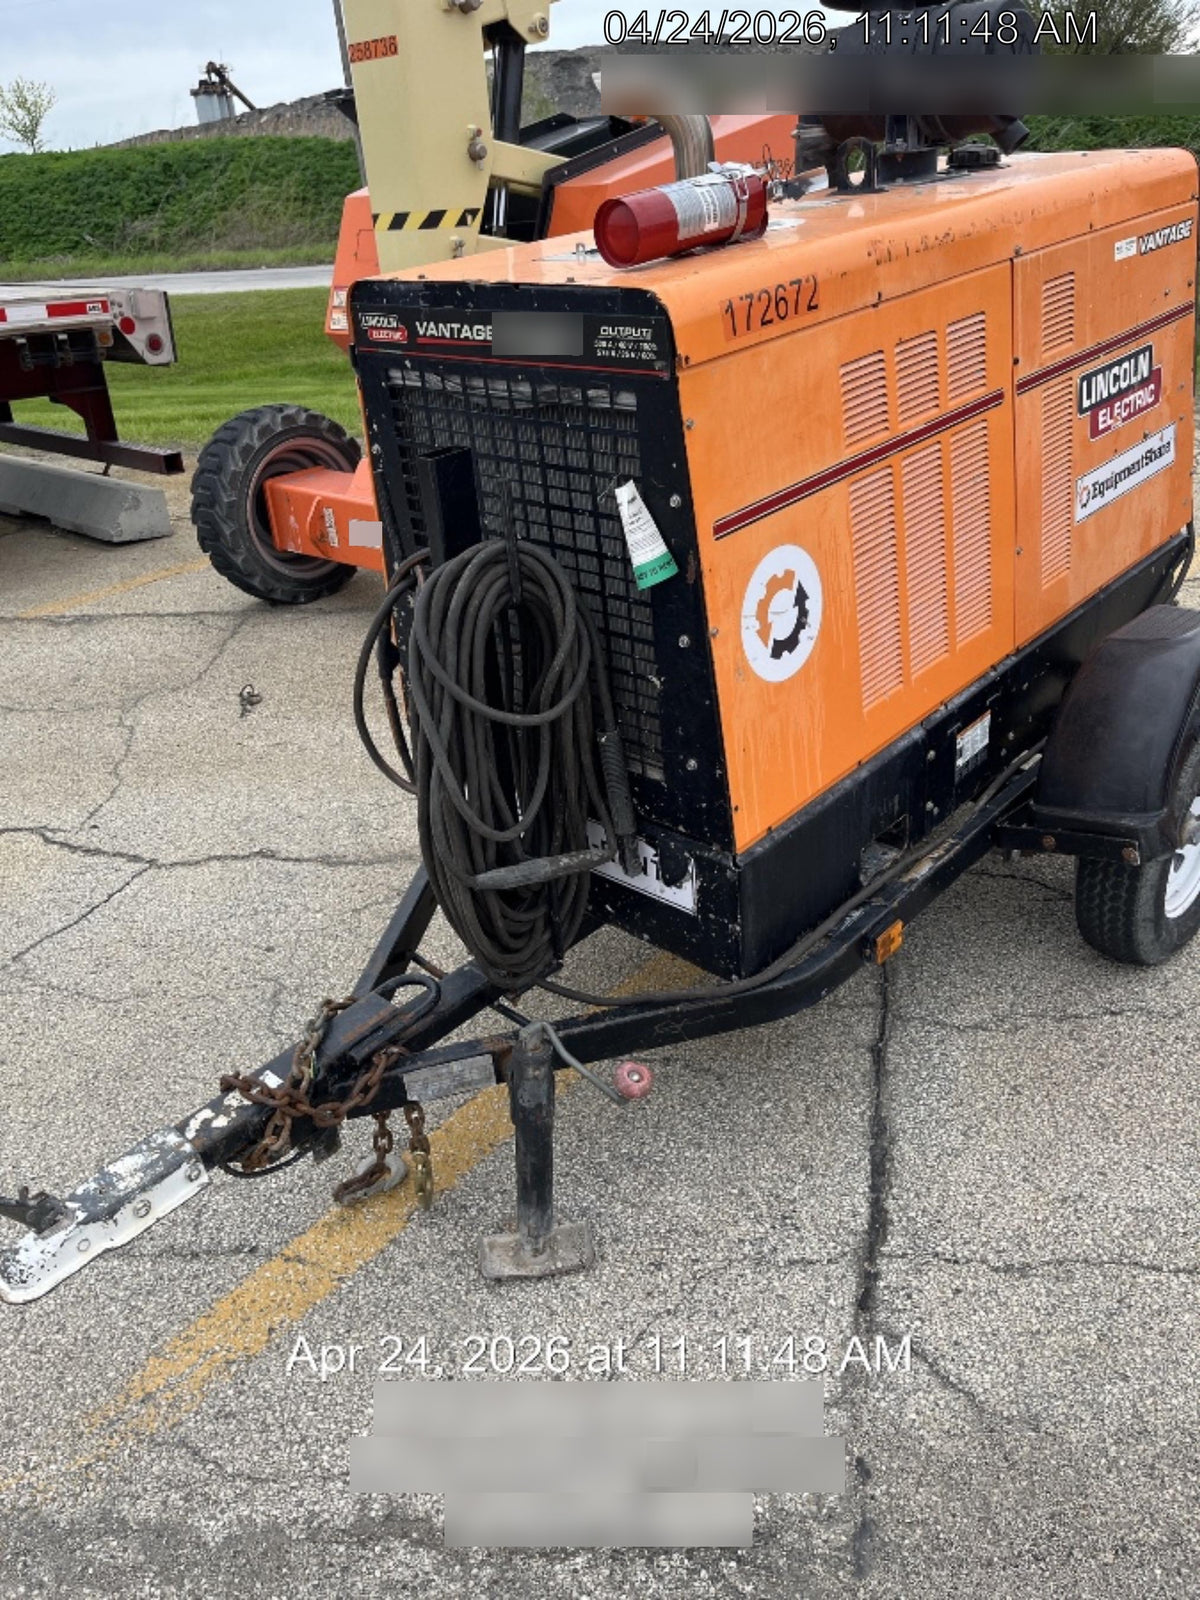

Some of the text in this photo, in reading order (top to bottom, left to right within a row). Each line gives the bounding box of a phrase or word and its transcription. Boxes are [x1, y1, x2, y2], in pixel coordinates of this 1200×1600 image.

[1138, 218, 1194, 255] VANTAGE
[724, 274, 819, 336] 172672
[415, 321, 493, 341] VANTAGE
[600, 326, 651, 337] OUTPUT
[1082, 351, 1149, 409] LINCOLN
[1098, 383, 1155, 431] ELECTRIC
[1092, 441, 1171, 500] EquipmentShare
